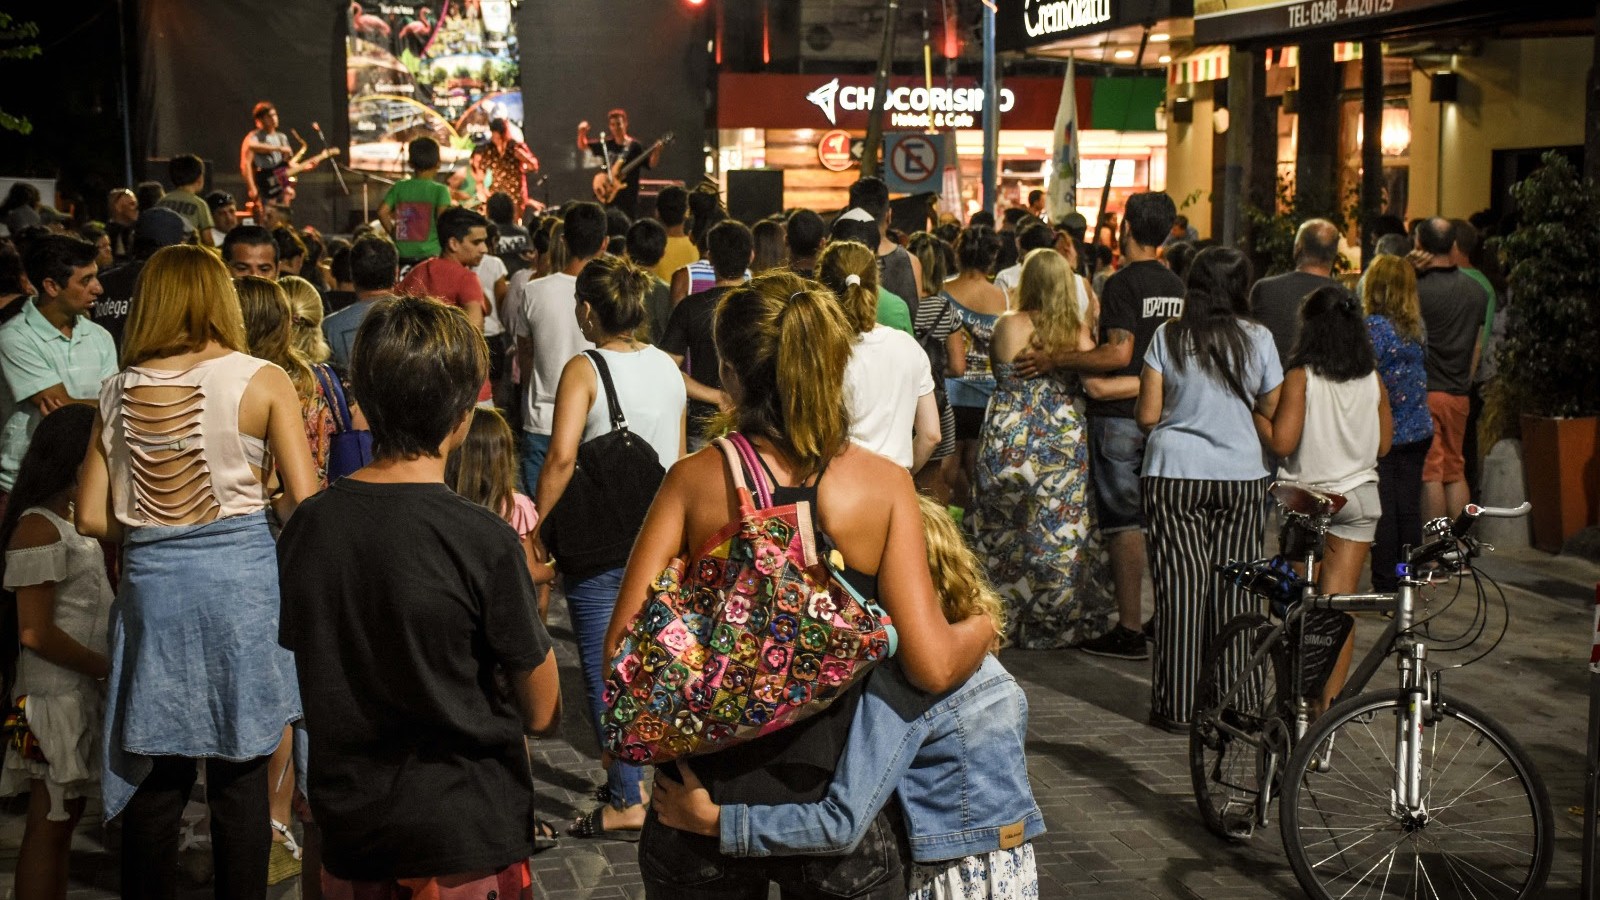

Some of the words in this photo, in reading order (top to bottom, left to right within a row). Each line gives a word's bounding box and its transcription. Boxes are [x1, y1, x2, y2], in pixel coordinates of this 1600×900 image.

[1288, 5, 1309, 28] TEL:
[1311, 2, 1337, 24] 0348
[934, 113, 945, 126] &
